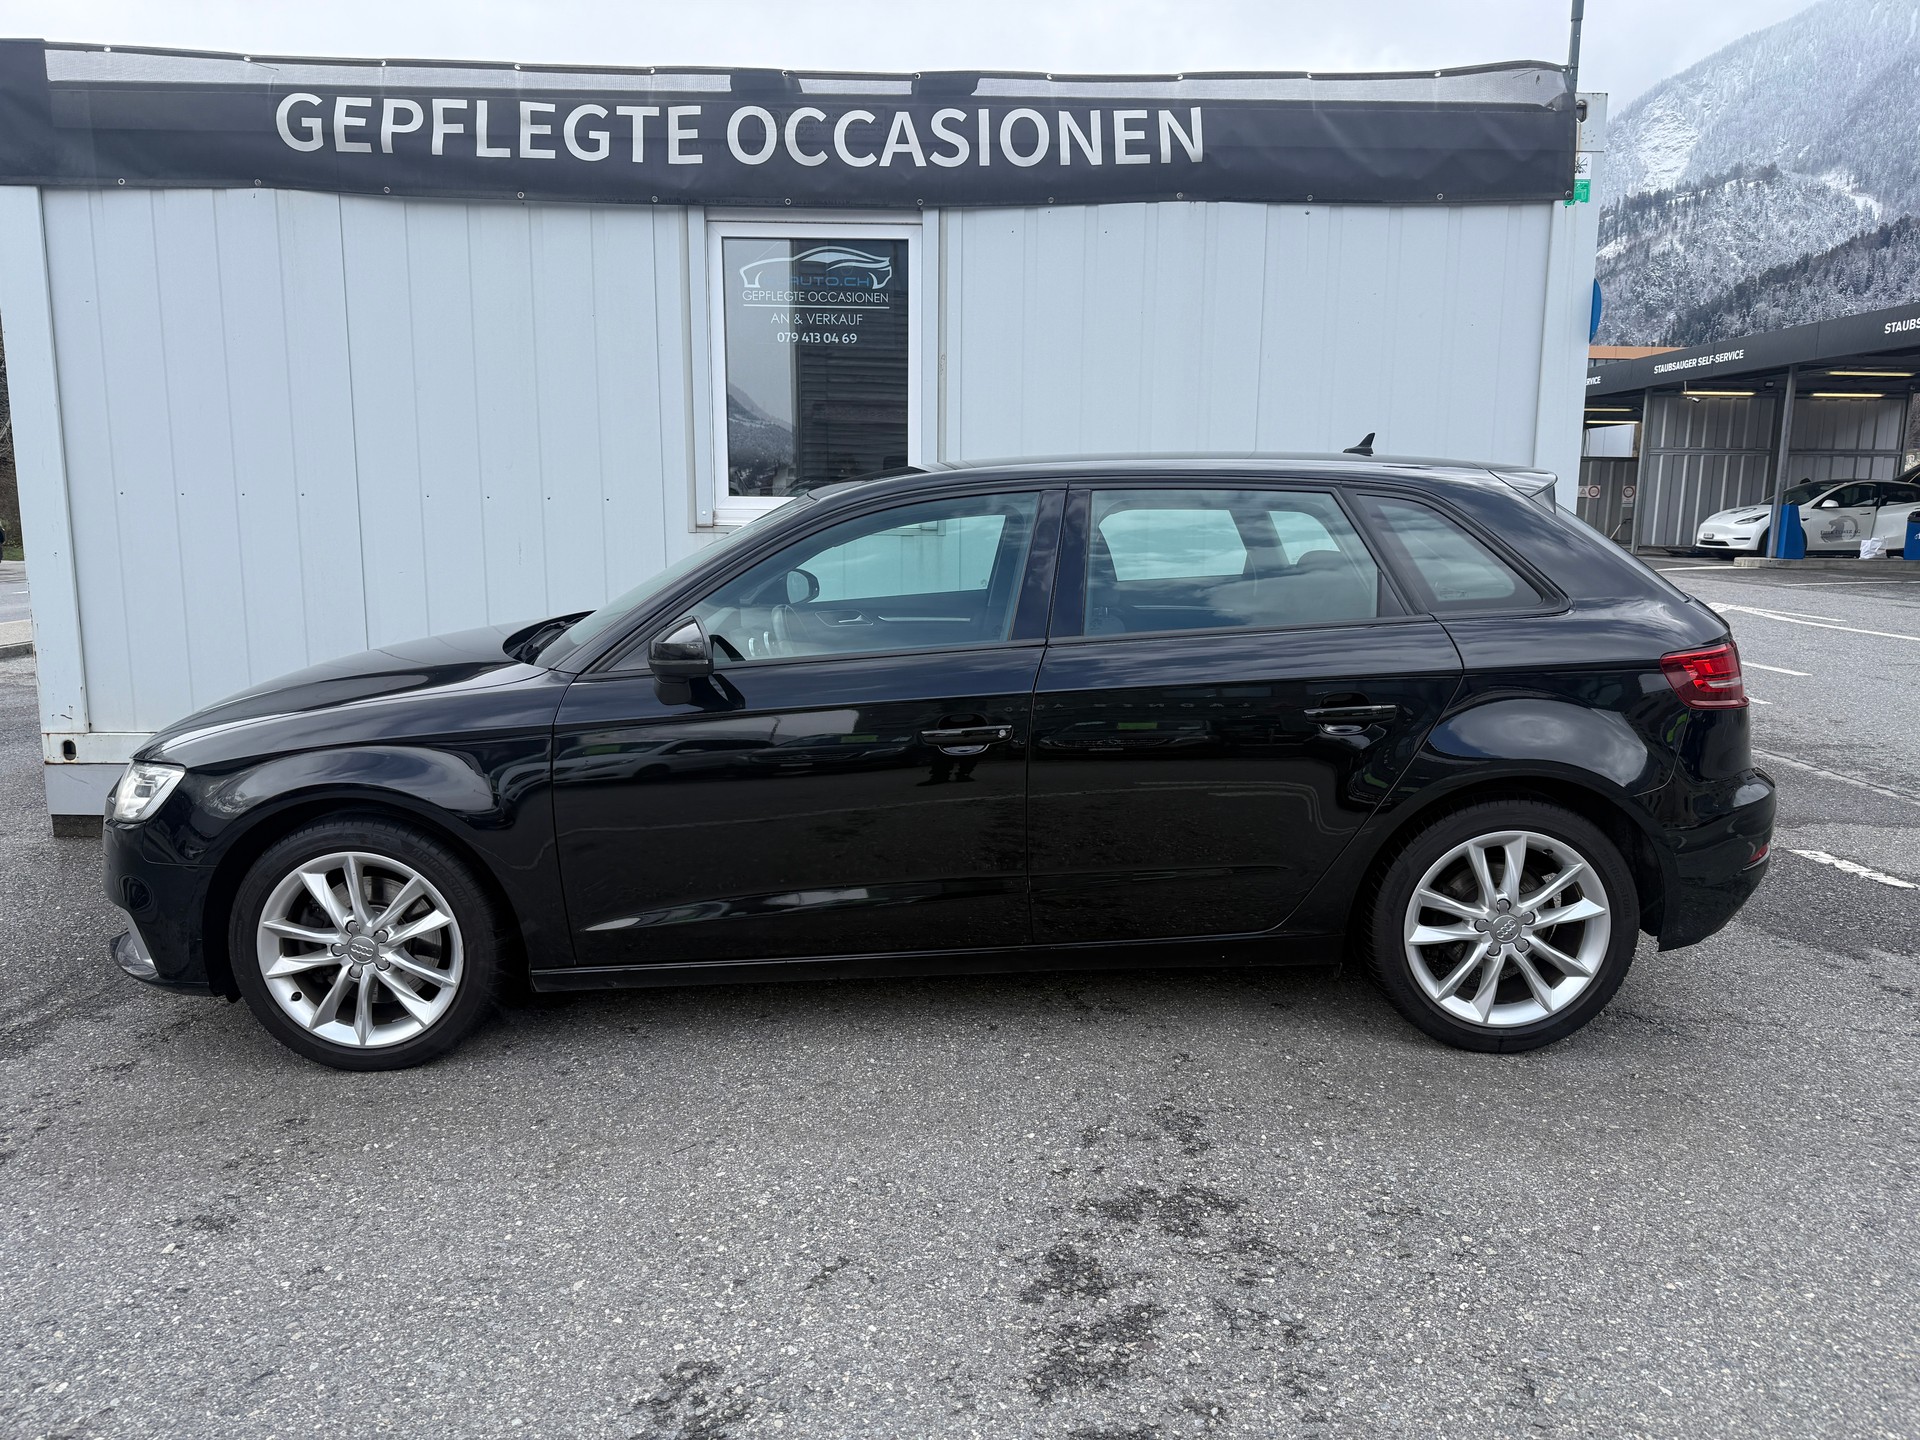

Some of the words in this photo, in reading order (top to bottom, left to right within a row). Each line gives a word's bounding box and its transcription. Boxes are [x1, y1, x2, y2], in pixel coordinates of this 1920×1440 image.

[275, 92, 704, 165] GEPFLEGTE
[726, 105, 1204, 168] OCCASIONEN
[742, 290, 805, 302] GEPFLEGTE
[807, 291, 889, 303] OCCASIONEN
[770, 313, 790, 324] AN
[793, 313, 803, 325] &
[806, 313, 863, 326] VERKAUF
[777, 332, 799, 343] 079
[801, 332, 820, 344] 413
[823, 333, 840, 344] 04
[842, 333, 858, 344] 69
[1653, 358, 1697, 374] STAUBSAUGER
[1697, 349, 1745, 367] SELF-SERVICE
[1585, 376, 1602, 386] RVICE
